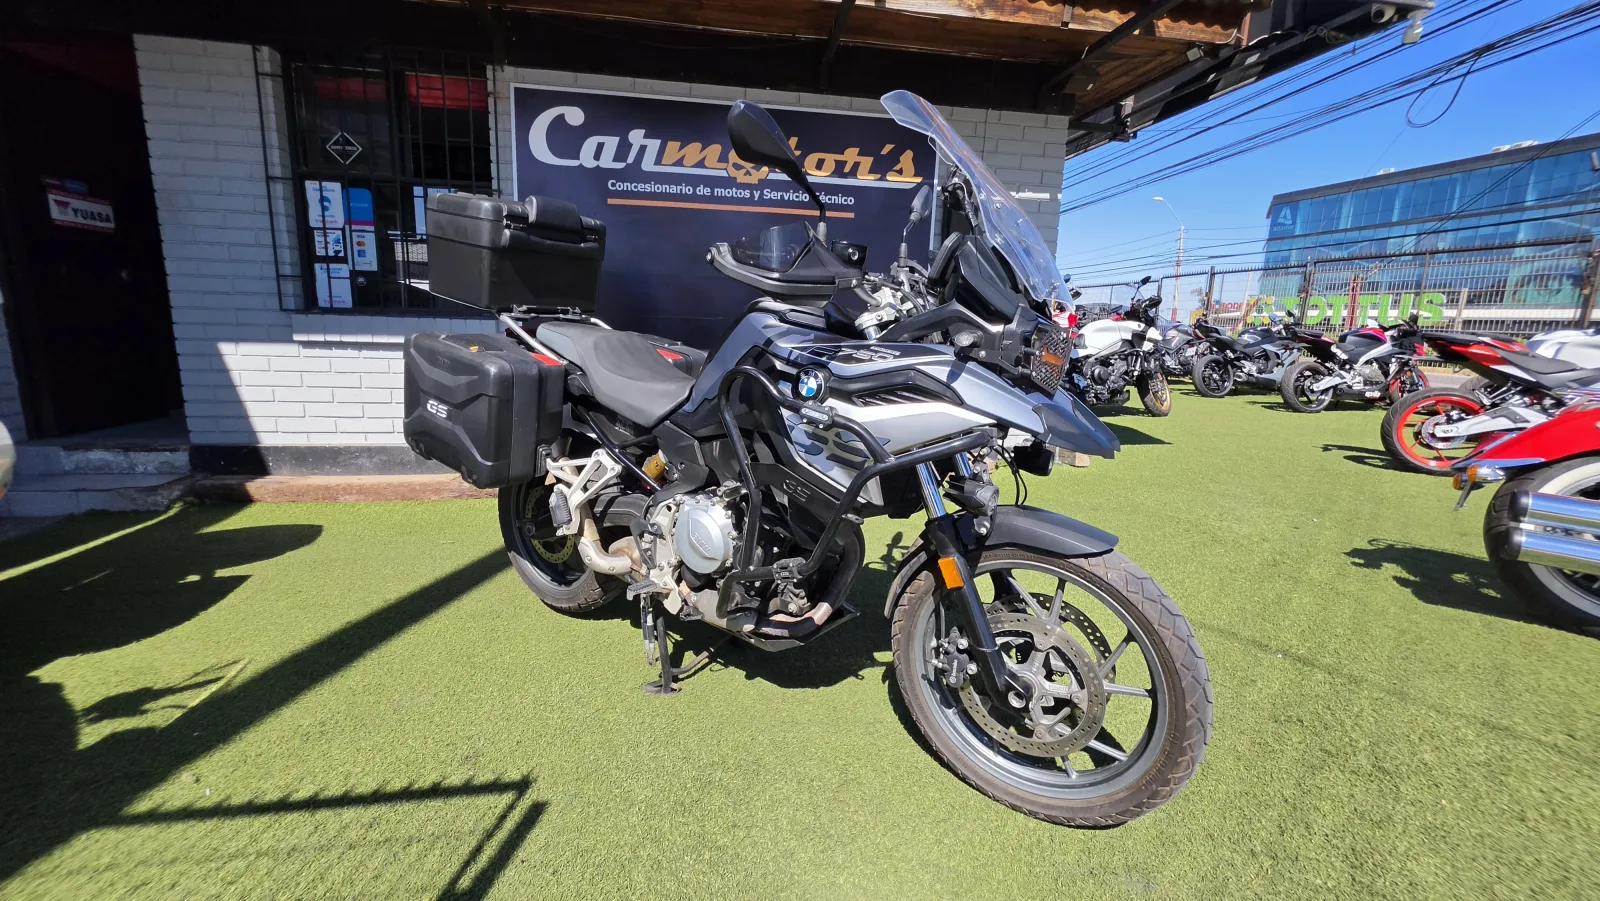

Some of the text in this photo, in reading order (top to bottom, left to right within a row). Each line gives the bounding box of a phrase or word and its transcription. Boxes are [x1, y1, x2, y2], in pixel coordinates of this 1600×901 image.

[528, 106, 923, 182] Carmor's
[607, 180, 855, 205] Concesionario de motos y Servicio écnico
[71, 207, 113, 224] YUASA
[1281, 293, 1447, 326] TOTTUS
[426, 399, 450, 418] GS
